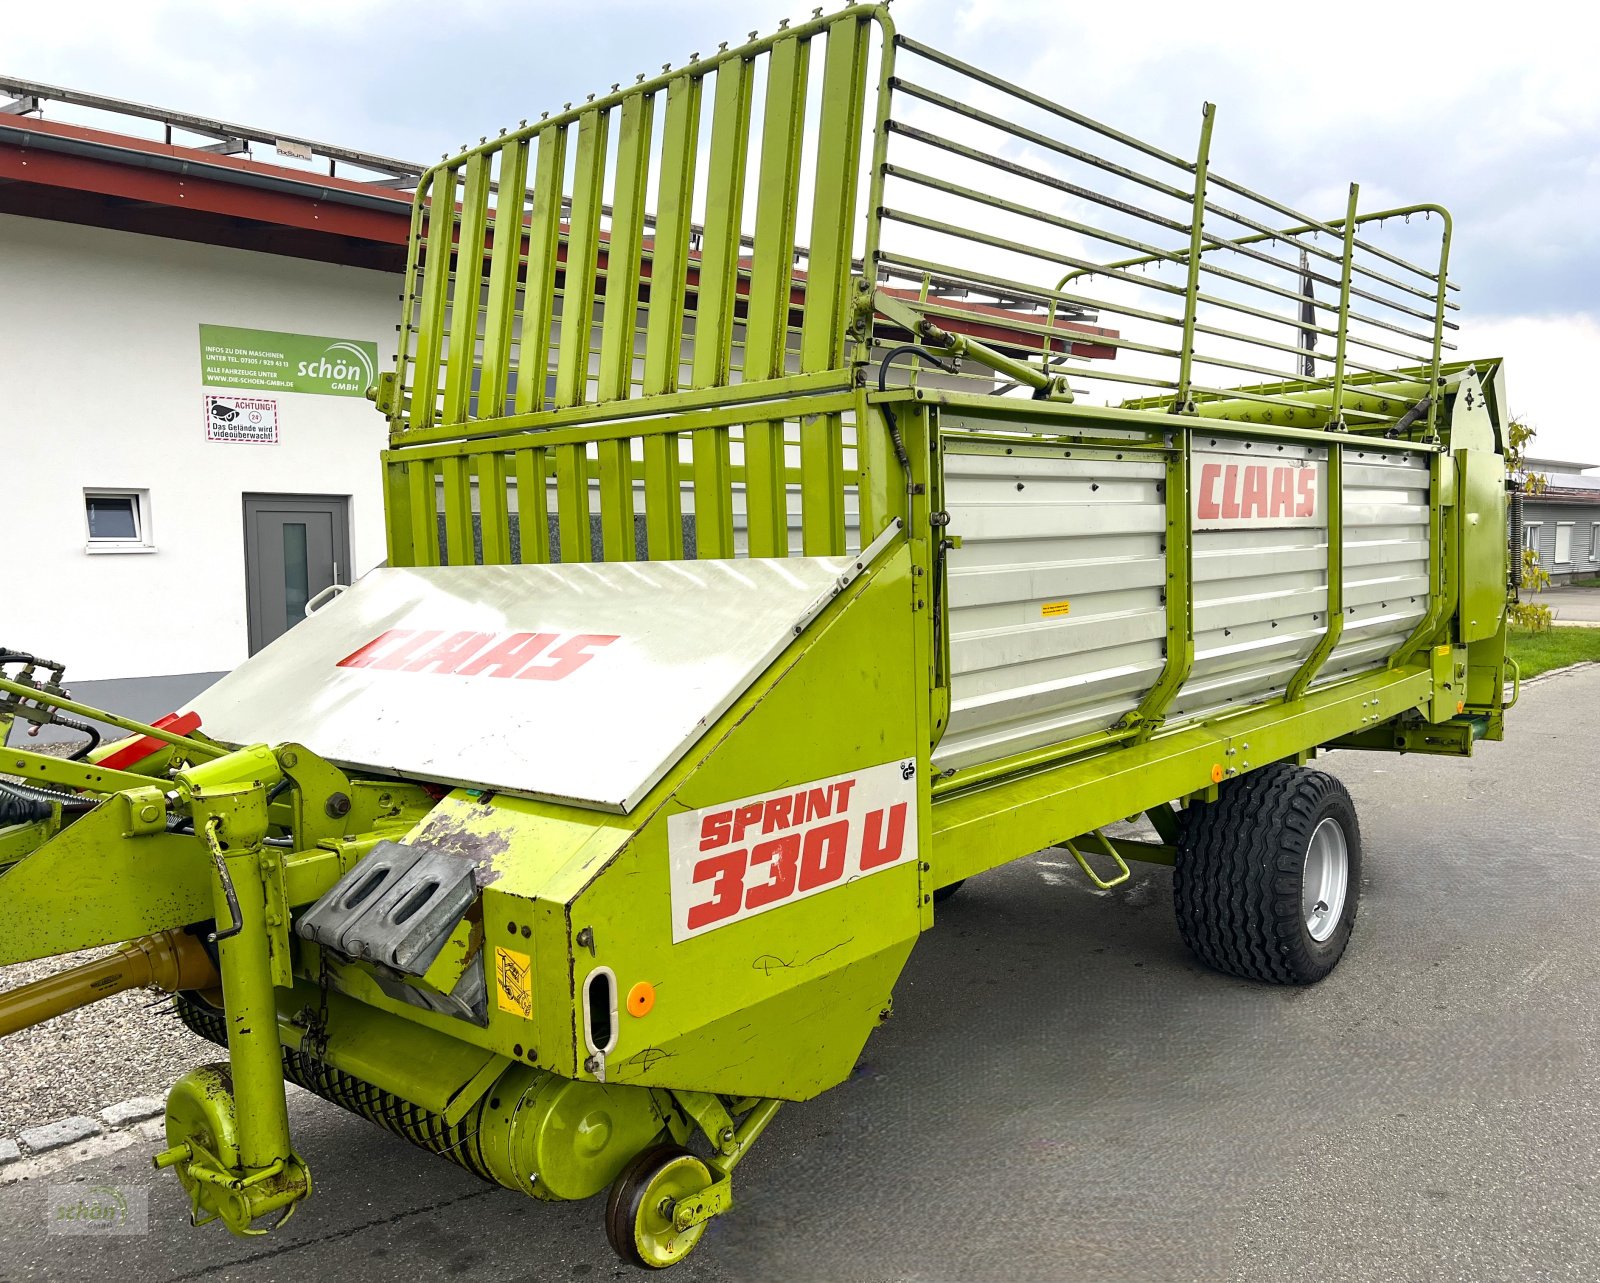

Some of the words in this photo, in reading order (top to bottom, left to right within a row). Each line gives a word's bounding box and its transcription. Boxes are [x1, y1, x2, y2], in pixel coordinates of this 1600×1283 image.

[205, 346, 224, 354] INFOS
[225, 347, 234, 355] ZU
[234, 348, 248, 356] DEN
[248, 350, 285, 359] MASCHINEN
[206, 354, 227, 363] UNTER
[206, 366, 221, 374] ALLE
[221, 368, 257, 376] FAHRZEUGE
[297, 357, 360, 380] schön
[207, 375, 294, 387] WWW.DIE-SCHOEN-GMBH.DE
[331, 382, 359, 391] GMBH
[234, 401, 273, 411] ACHTUNG!
[212, 422, 227, 431] Das
[227, 423, 257, 432] Gelände
[213, 430, 273, 440] videoüberwacht!
[1197, 463, 1316, 519] CLAAS
[335, 629, 621, 681] CLAAS
[699, 779, 856, 852] SPRINT
[687, 819, 850, 930] 330
[859, 801, 908, 872] U
